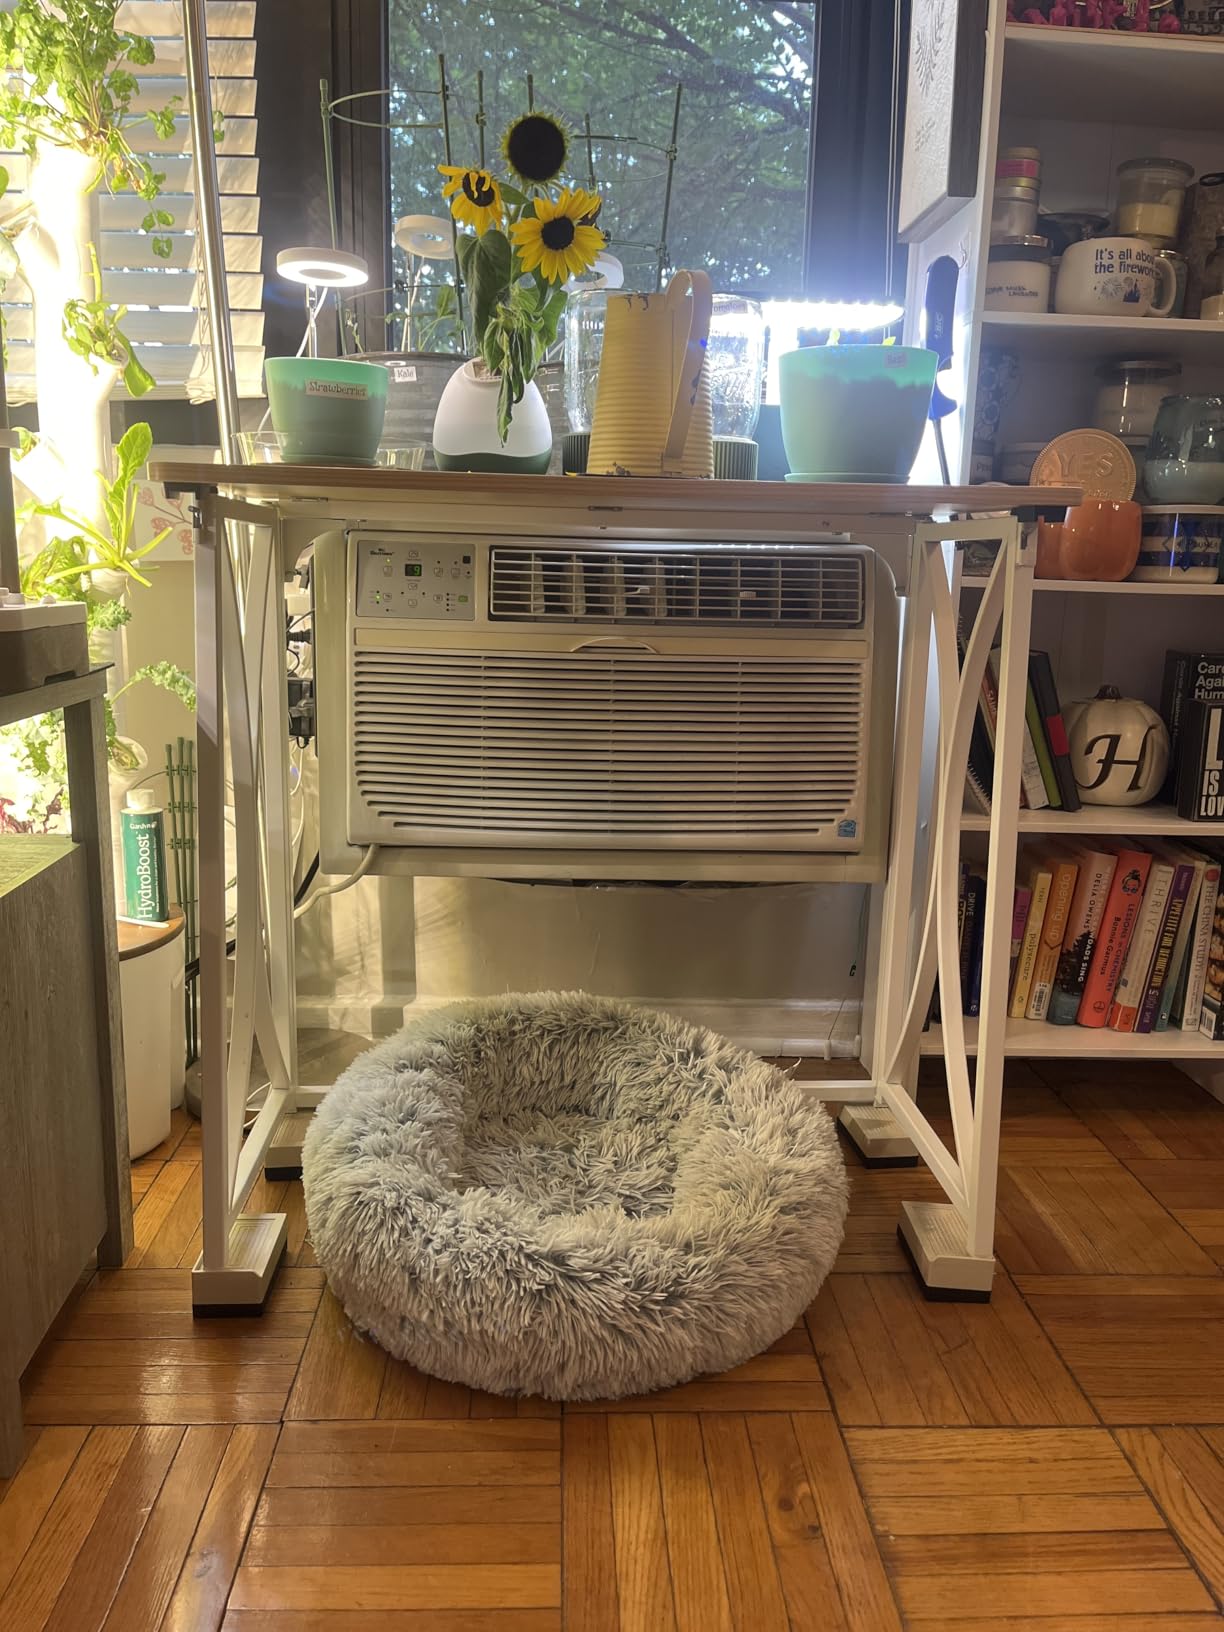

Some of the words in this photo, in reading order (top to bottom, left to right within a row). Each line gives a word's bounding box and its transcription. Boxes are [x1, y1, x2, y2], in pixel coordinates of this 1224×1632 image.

[1094, 262, 1114, 274] the
[1119, 261, 1155, 277] firewor
[1095, 248, 1114, 260] It's
[1118, 248, 1132, 259] all
[1135, 250, 1155, 264] abou
[397, 369, 414, 379] Kale
[309, 381, 367, 397] Strawberries
[1056, 448, 1113, 478] YES
[1073, 723, 1160, 793] H
[1202, 770, 1220, 796] IS
[136, 833, 155, 919] HydroBoost
[1091, 873, 1103, 897] DELIA
[966, 892, 977, 917] DRIVE
[1053, 873, 1072, 922] opening
[1143, 877, 1168, 937] THRIVE
[1204, 884, 1216, 905] THE
[1083, 900, 1097, 929] OWENS
[1120, 903, 1136, 939] LESSONS
[1165, 897, 1185, 932] APPETITE
[1199, 905, 1213, 937] CHINA
[1048, 924, 1061, 941] up
[1108, 915, 1121, 944] Bonnie
[1161, 931, 1177, 948] FOR
[1023, 933, 1038, 981] polysecure
[1100, 945, 1114, 976] Garmus
[1194, 937, 1208, 972] STUDY
[1077, 962, 1089, 983] SING
[1106, 949, 1123, 992] CHEMISTRY
